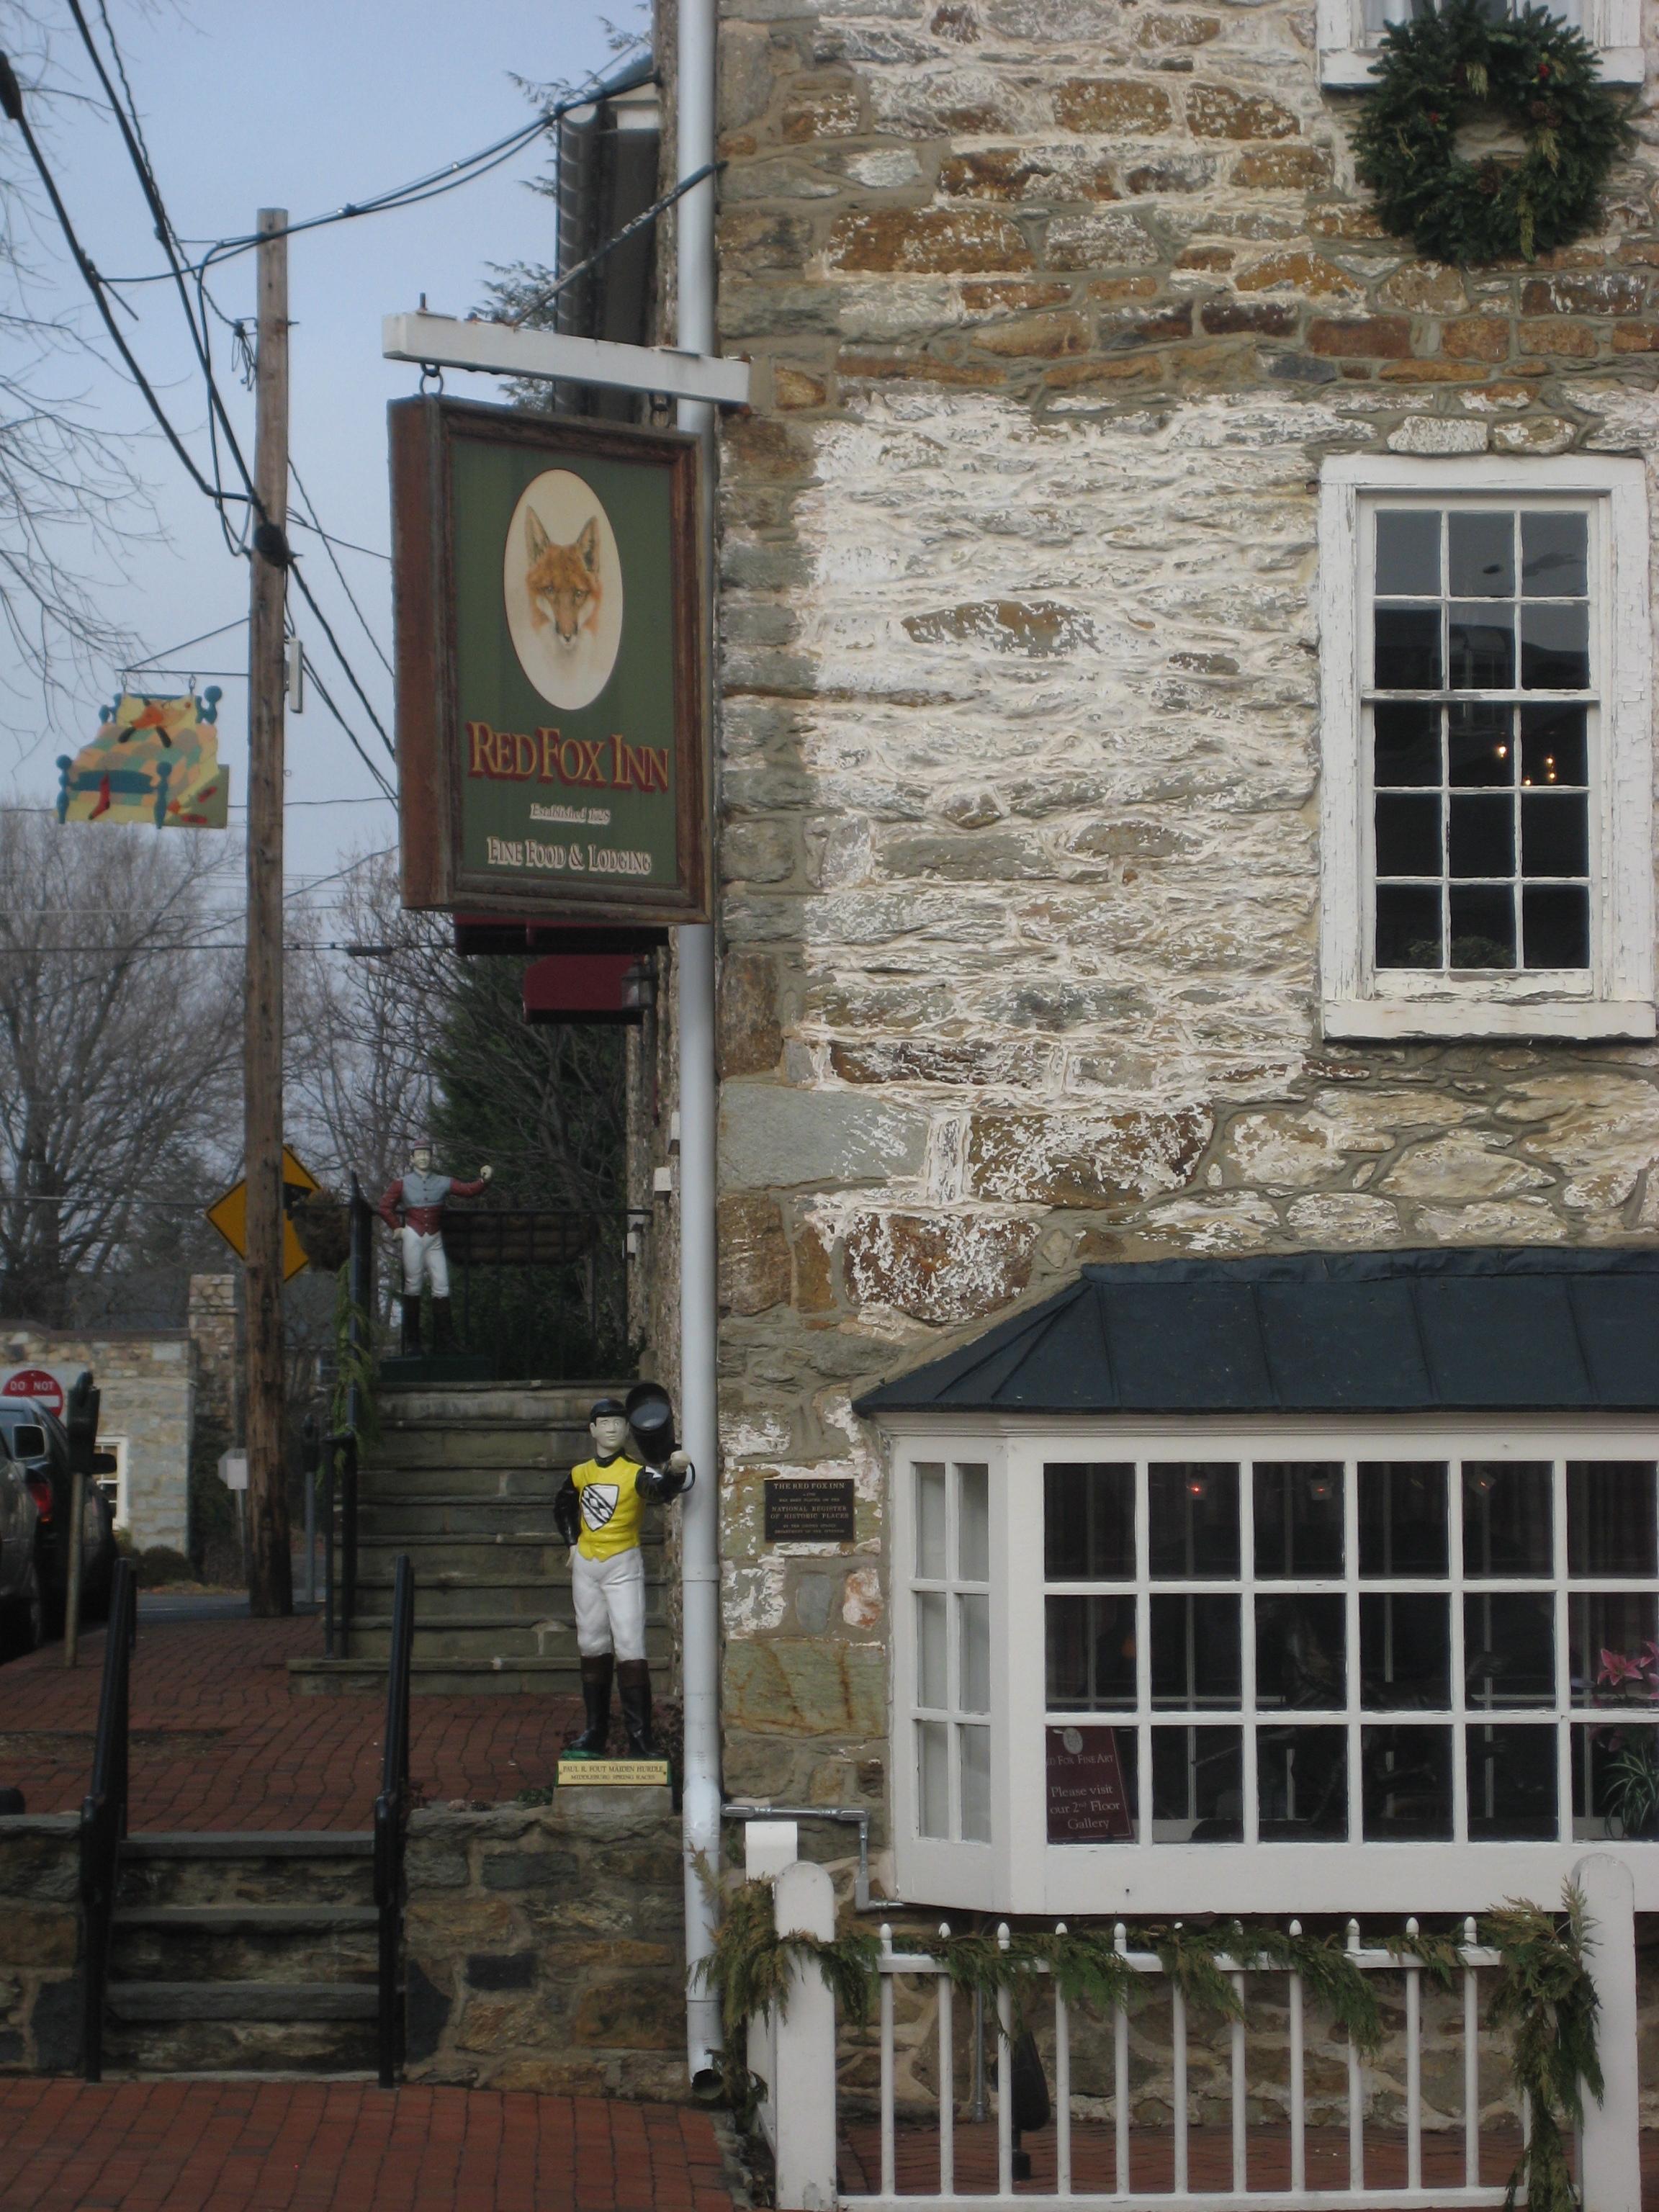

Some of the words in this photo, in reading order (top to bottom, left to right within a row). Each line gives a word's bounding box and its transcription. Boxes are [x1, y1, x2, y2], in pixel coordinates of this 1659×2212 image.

[466, 721, 537, 781] RED
[536, 726, 607, 788] FOX
[608, 734, 669, 793] INN
[529, 803, 586, 823] Established
[487, 836, 522, 866] FINE
[525, 839, 566, 868] FOOD
[568, 842, 585, 870] &
[588, 844, 652, 874] LODGING
[10, 1381, 26, 1390] DO
[33, 1381, 54, 1390] NOT
[1058, 1755, 1074, 1765] FOX
[1077, 1754, 1097, 1763] FINE
[1097, 1753, 1114, 1763] ART
[1050, 1786, 1087, 1797] Please
[1089, 1784, 1114, 1795] visit
[1050, 1806, 1070, 1815] our
[1090, 1800, 1120, 1812] Floor
[1067, 1817, 1110, 1830] Gallery
